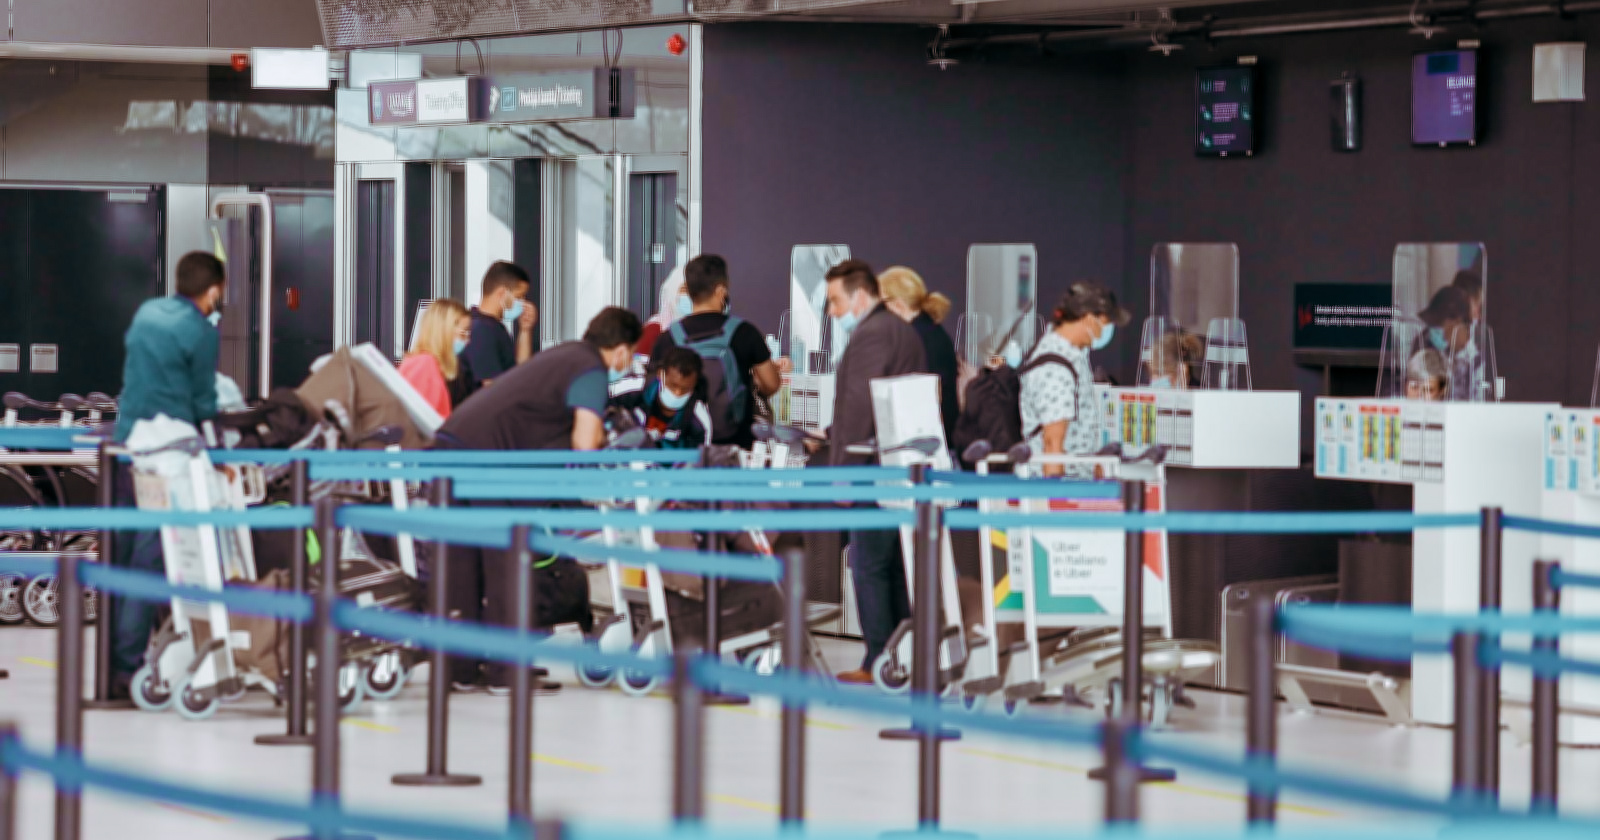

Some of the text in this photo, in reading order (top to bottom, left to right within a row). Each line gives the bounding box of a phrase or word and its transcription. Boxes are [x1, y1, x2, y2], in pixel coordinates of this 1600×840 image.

[1052, 541, 1081, 552] Uber
[1053, 555, 1063, 565] in
[1063, 567, 1092, 579] Uber
